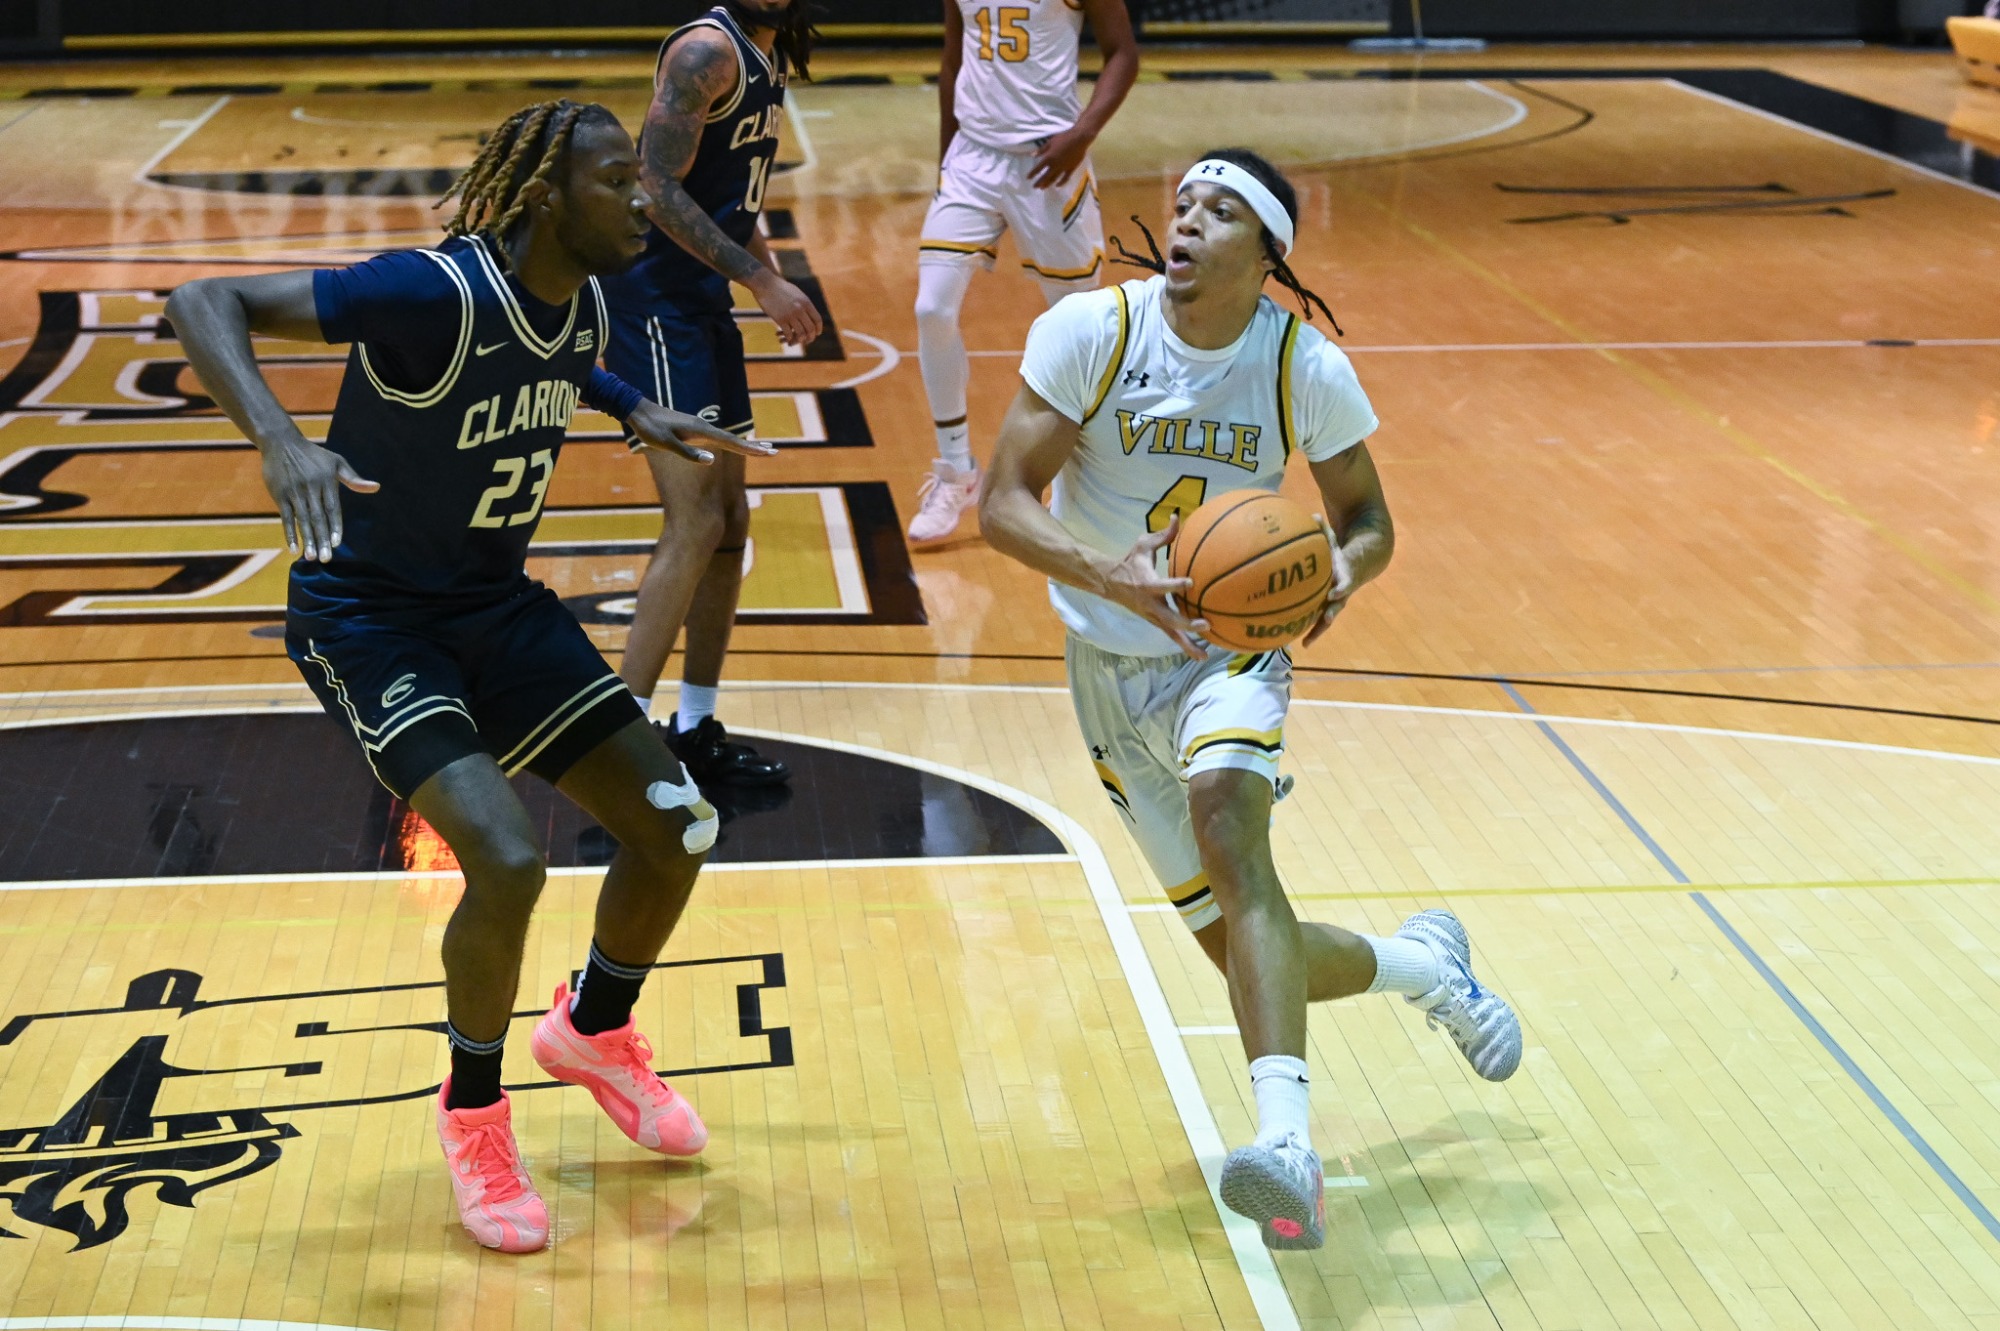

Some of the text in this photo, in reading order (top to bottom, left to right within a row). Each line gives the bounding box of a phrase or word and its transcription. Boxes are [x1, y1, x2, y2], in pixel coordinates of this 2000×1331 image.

[974, 7, 1030, 62] 15
[1115, 409, 1262, 473] VILLE
[467, 448, 554, 528] 23
[1145, 475, 1207, 550] 4
[1267, 552, 1318, 594] EVO
